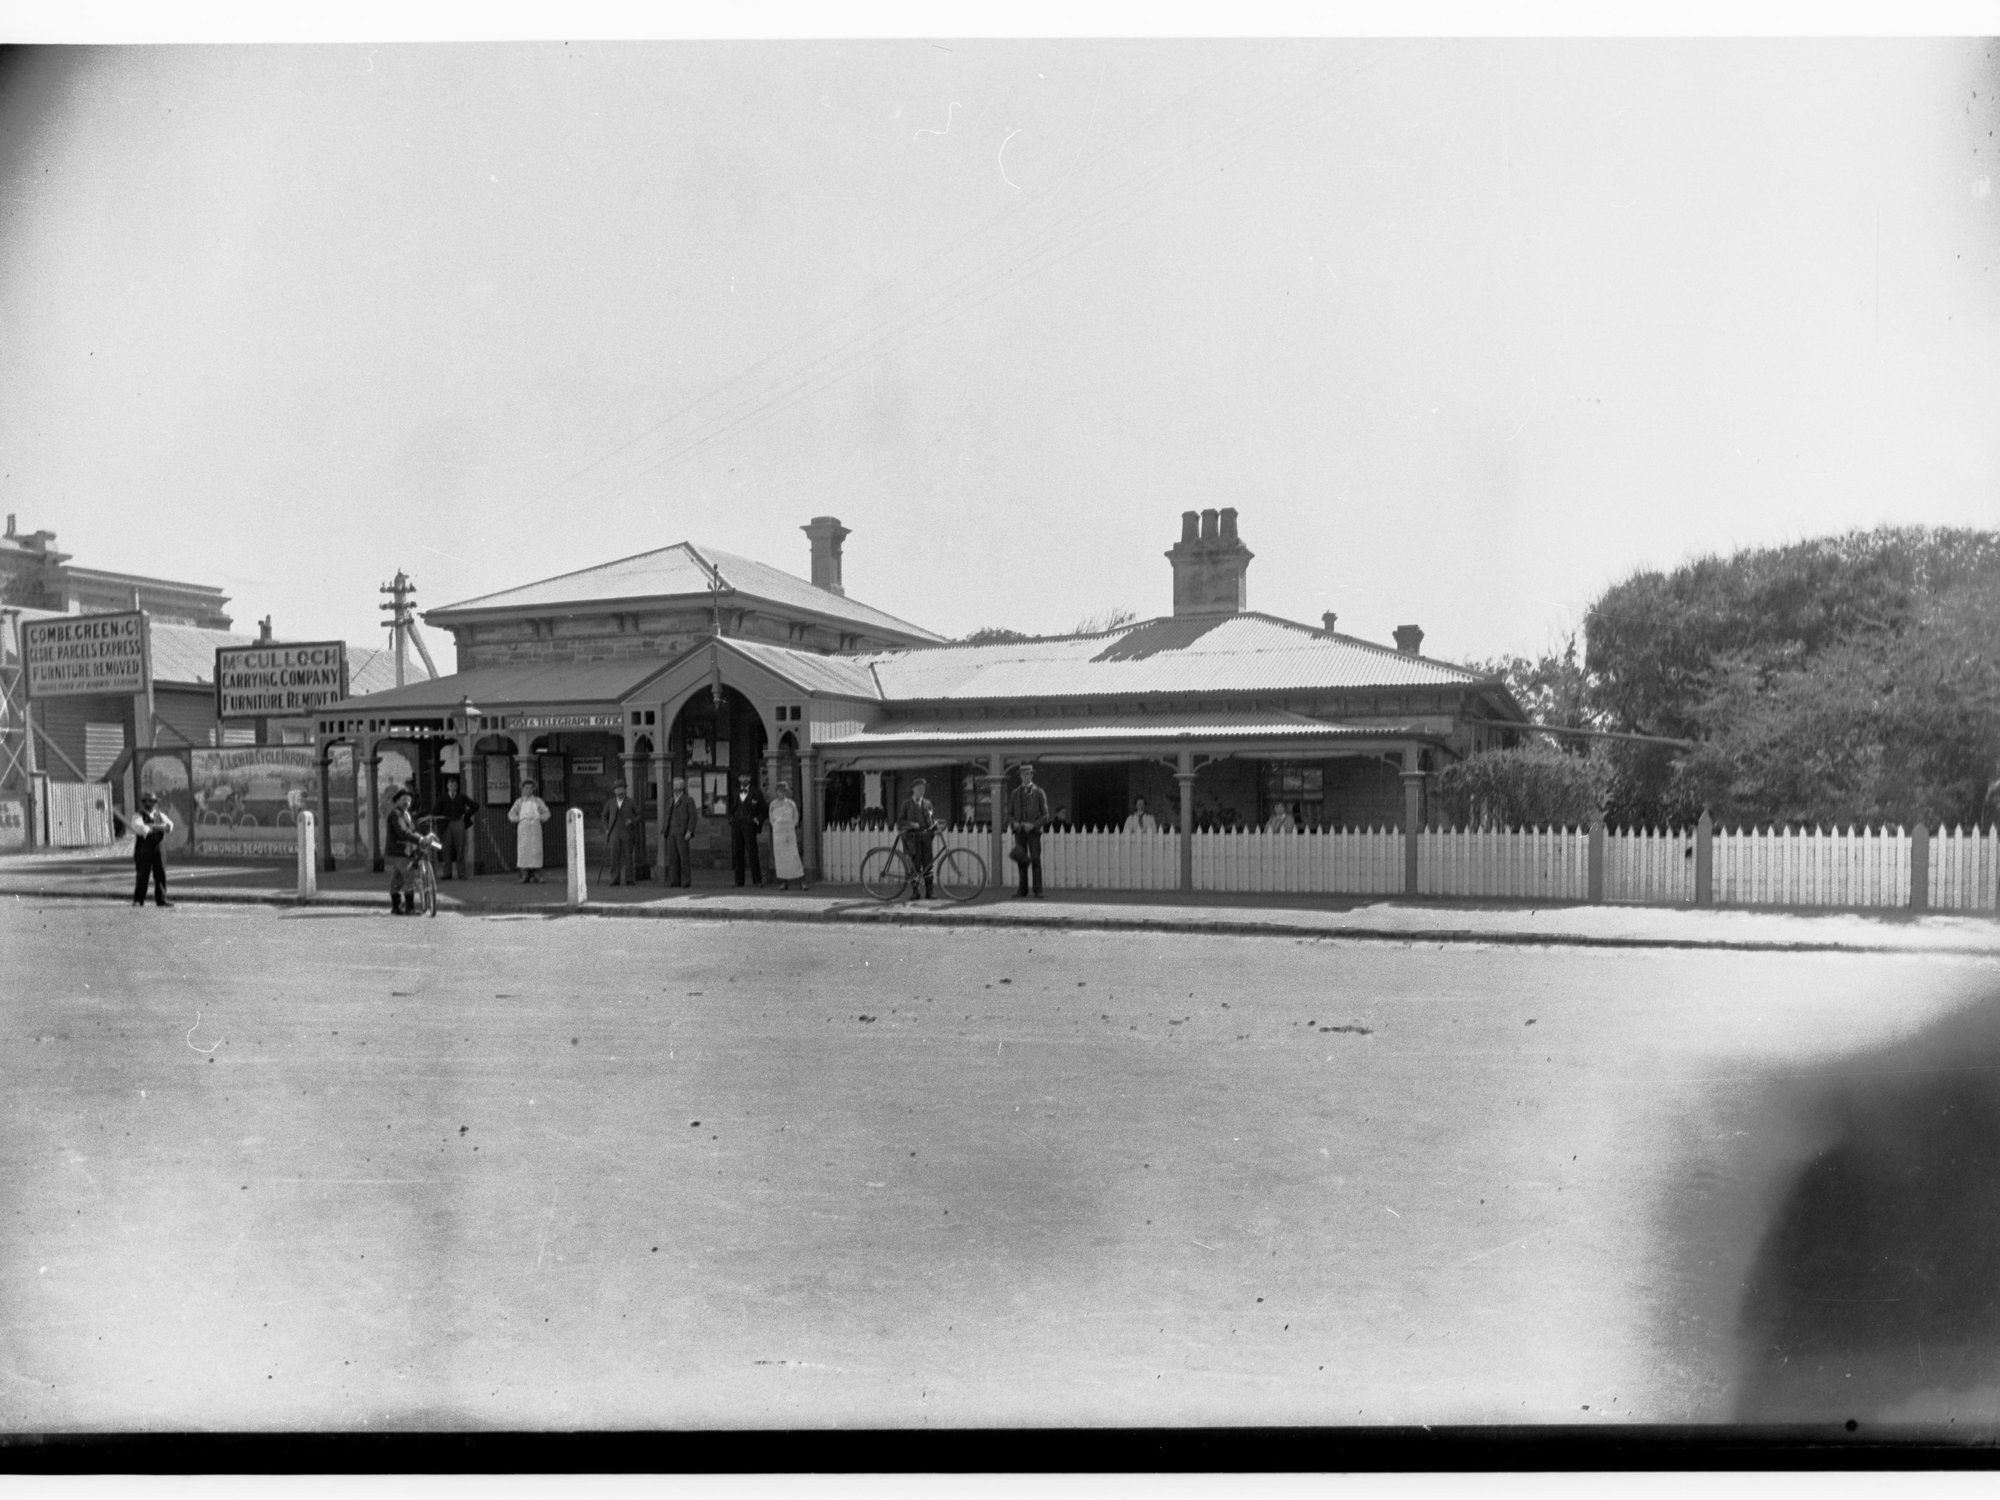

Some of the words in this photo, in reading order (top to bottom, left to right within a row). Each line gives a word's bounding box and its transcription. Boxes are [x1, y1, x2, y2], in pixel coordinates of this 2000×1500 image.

[75, 621, 119, 639] GREEN
[58, 642, 98, 660] PARCELS
[100, 640, 141, 657] EXPRESS
[33, 662, 91, 683] FURNITURE
[93, 660, 140, 678] REMOVED
[222, 671, 278, 689] CARRYING
[280, 668, 339, 687] COMPANY
[222, 692, 285, 711] FURNITURE
[508, 717, 527, 728] POST
[538, 716, 590, 728] TELEGRAPH
